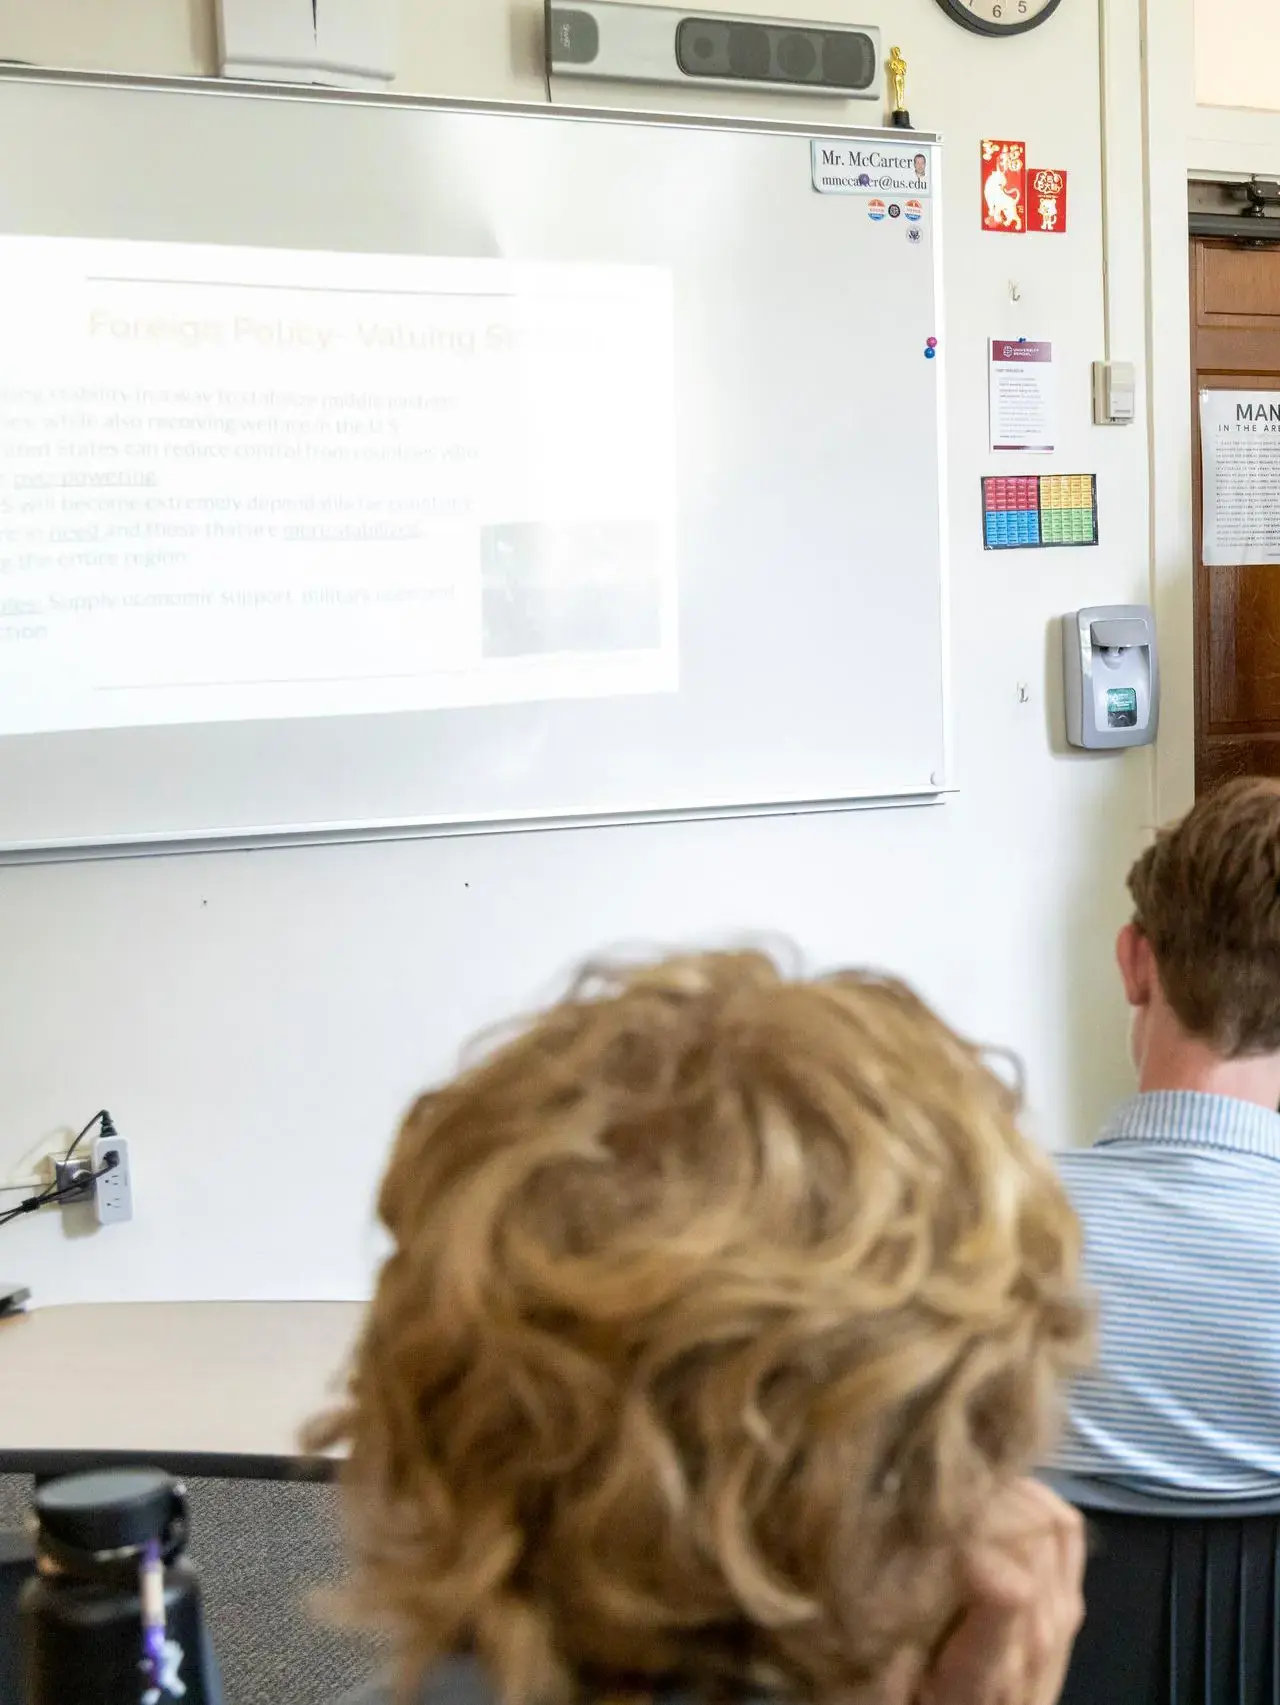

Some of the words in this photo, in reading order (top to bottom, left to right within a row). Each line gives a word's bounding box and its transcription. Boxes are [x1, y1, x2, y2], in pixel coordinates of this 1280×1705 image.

[992, 4, 1002, 18] 6
[1017, 1, 1027, 13] 5
[821, 149, 845, 166] Mr.
[849, 150, 914, 169] McCarter
[821, 175, 928, 191] mmccaer@us.edu
[88, 307, 225, 348] Foreign
[357, 319, 476, 358] Valuing
[1218, 424, 1230, 432] IN
[1236, 424, 1257, 432] THE
